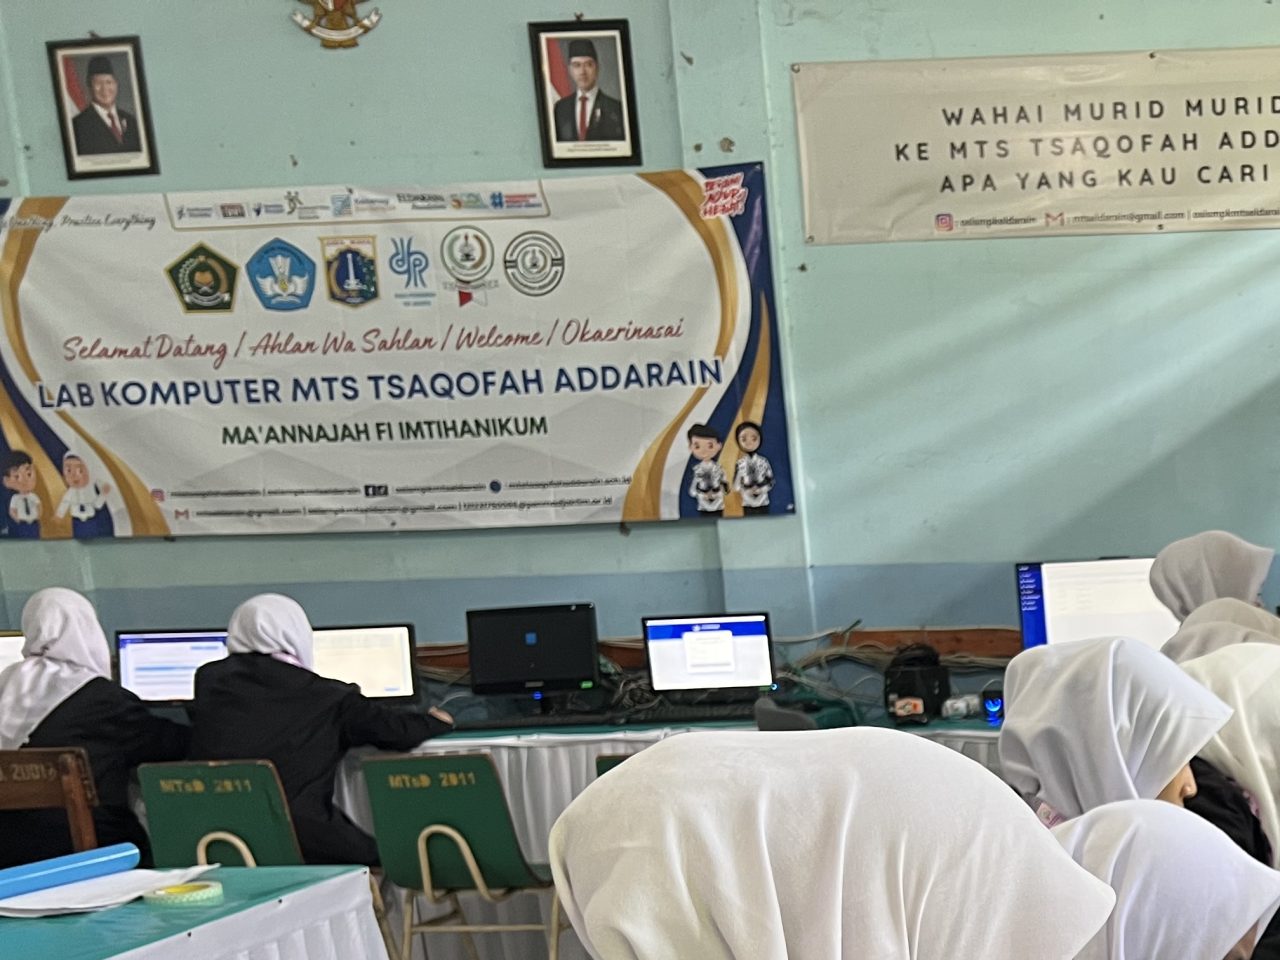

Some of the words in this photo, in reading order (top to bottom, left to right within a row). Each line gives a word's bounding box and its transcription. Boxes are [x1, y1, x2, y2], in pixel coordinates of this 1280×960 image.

[942, 105, 1043, 126] WAHAI
[1064, 100, 1165, 121] MURID
[895, 142, 930, 162] KE
[950, 140, 1010, 160] MTS
[1029, 133, 1199, 158] TSAQOFAH
[940, 172, 997, 193] APA
[1015, 170, 1098, 191] YANG
[1118, 166, 1177, 187] KAU
[1197, 163, 1269, 184] CARI
[63, 336, 153, 362] Selamat
[155, 334, 228, 370] Datang
[251, 331, 319, 356] Ahlan
[322, 331, 357, 356] Wa
[362, 327, 436, 353] Sahlan
[456, 325, 544, 351] Welcome
[562, 318, 685, 345] Okaerinasai
[38, 380, 95, 408] LAB
[102, 377, 281, 407] KOMPUTER
[292, 376, 360, 402] MTS
[367, 369, 545, 400] TSAQOFAH
[554, 359, 722, 394] ADDARAIN
[222, 422, 370, 446] MA'ANNAJAH
[375, 421, 393, 442] FI
[398, 416, 549, 441] IMTIHANIKUM
